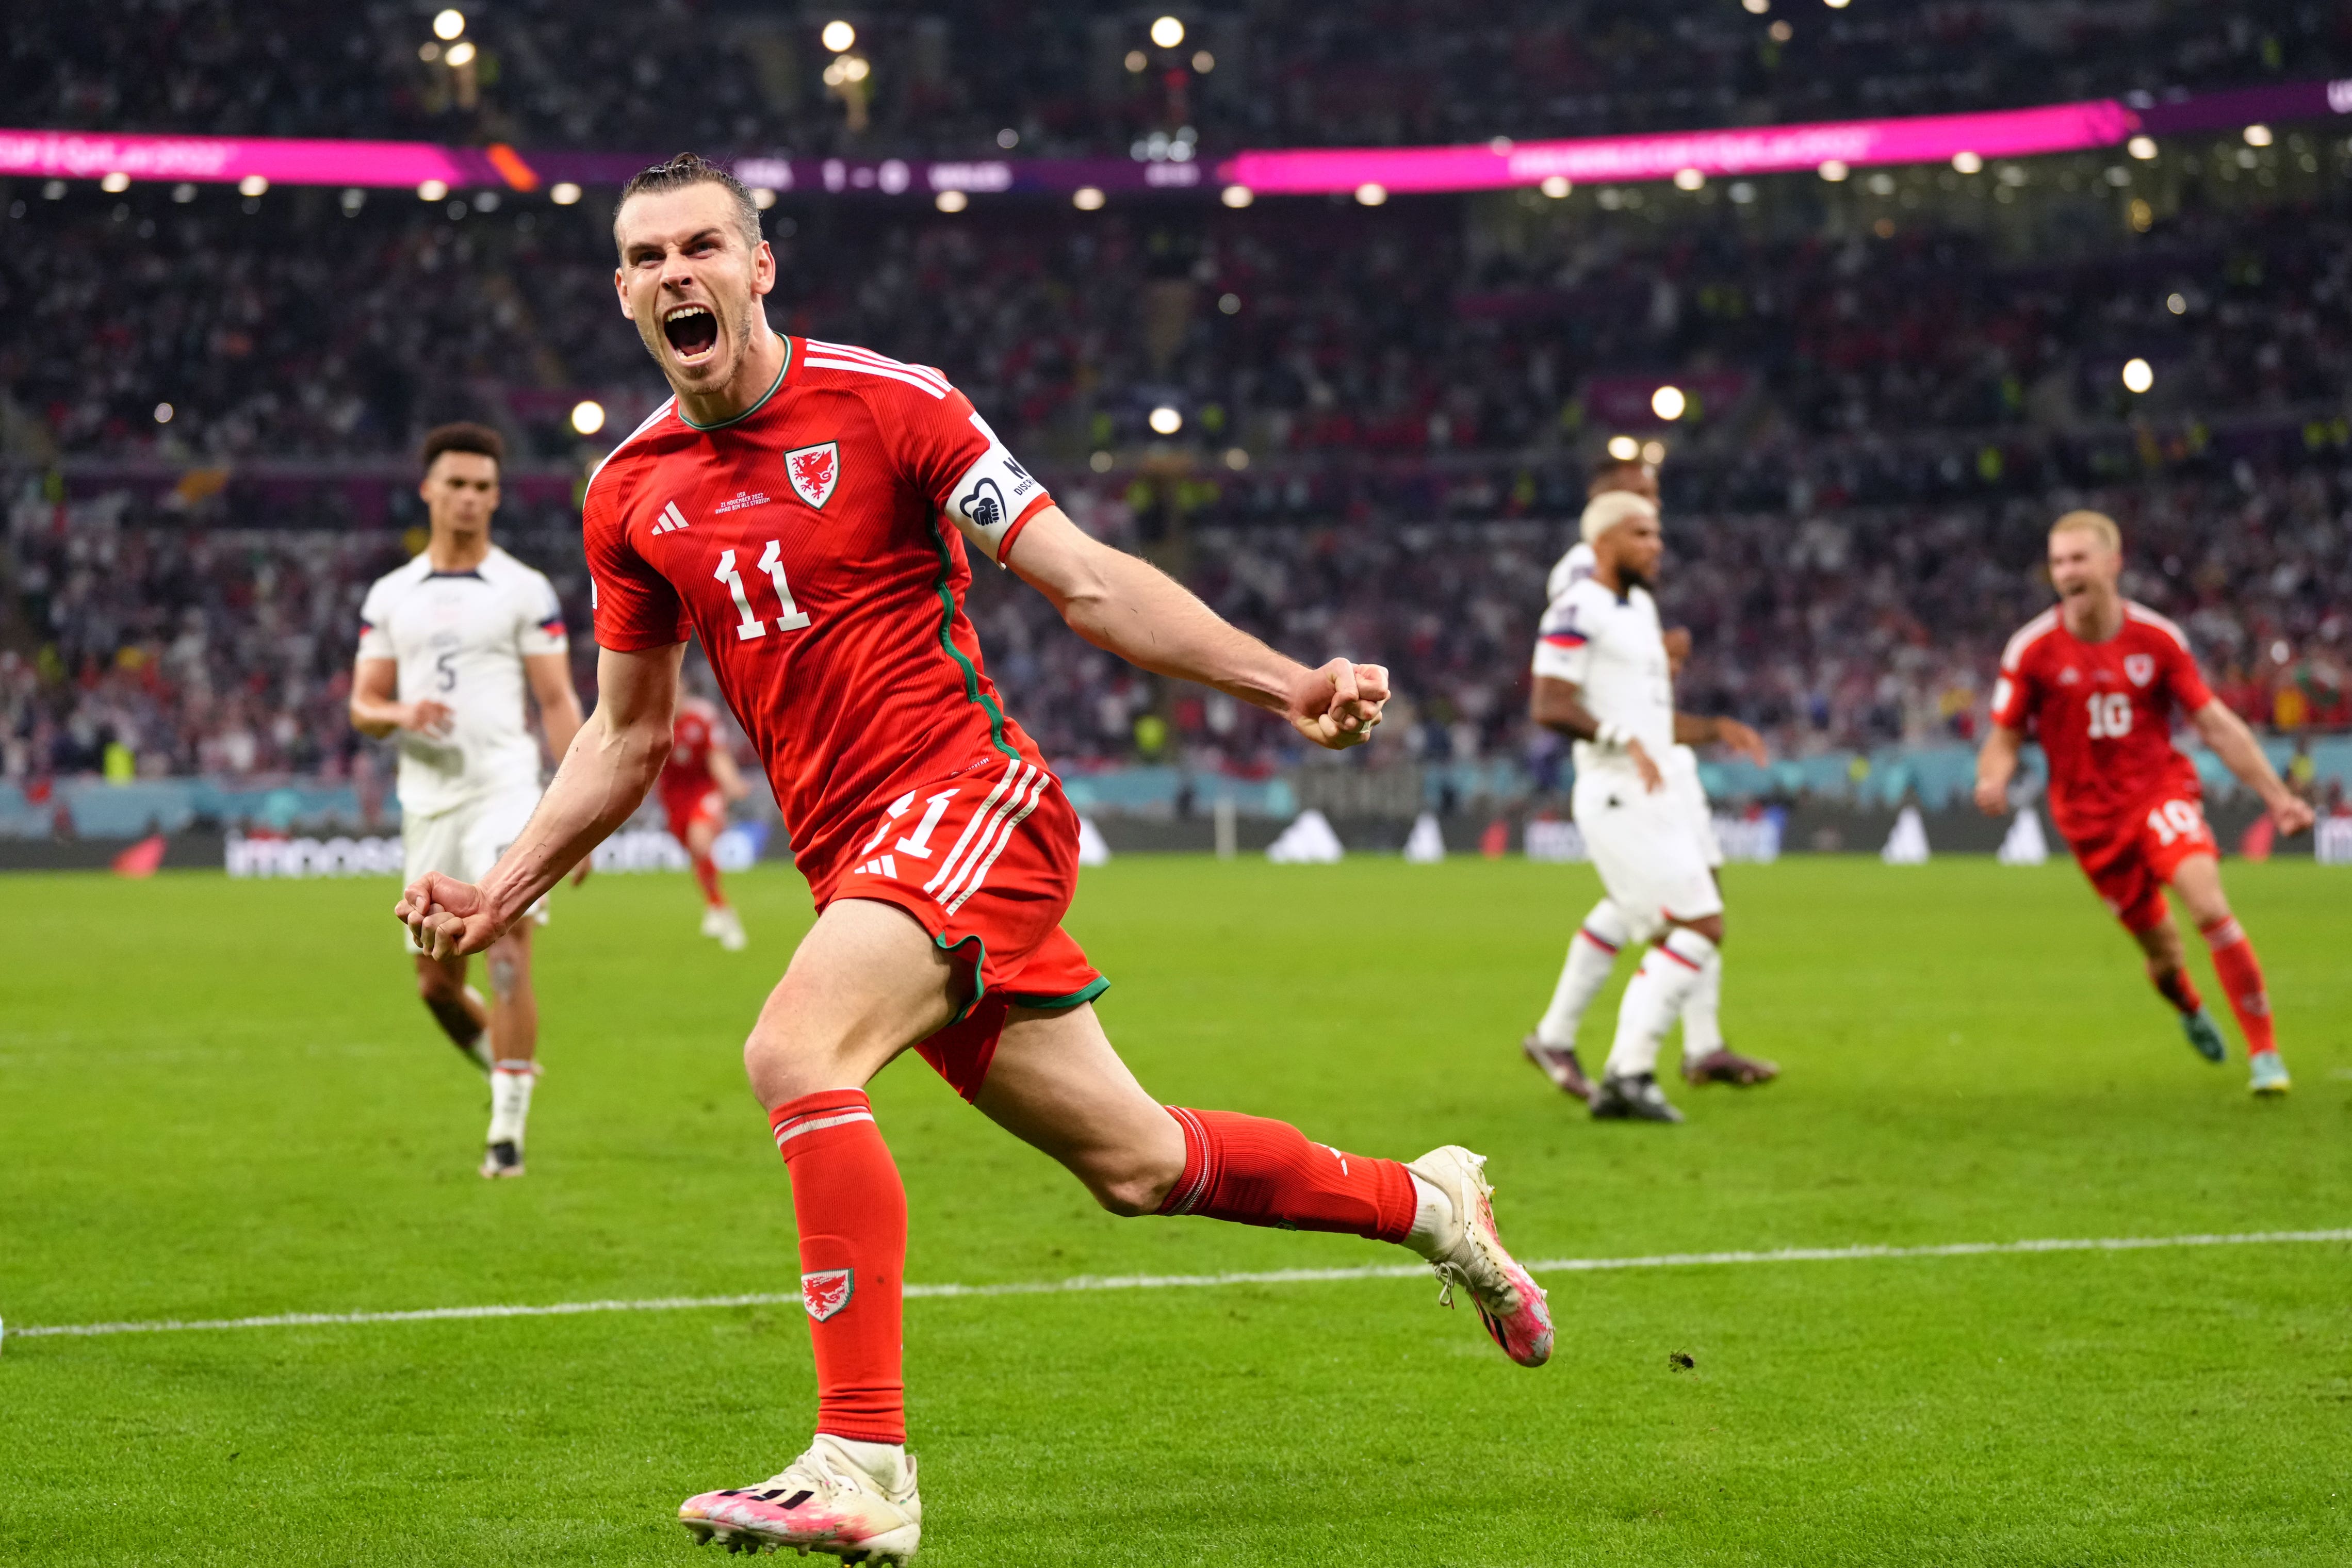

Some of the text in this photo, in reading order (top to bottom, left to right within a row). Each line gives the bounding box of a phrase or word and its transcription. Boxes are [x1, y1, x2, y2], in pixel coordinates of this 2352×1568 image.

[727, 496, 751, 506] NOVEMBER
[750, 497, 771, 507] STADIUM
[713, 540, 811, 641] 11
[437, 651, 458, 693] 5
[2086, 692, 2132, 739] 10
[2147, 799, 2198, 845] 10
